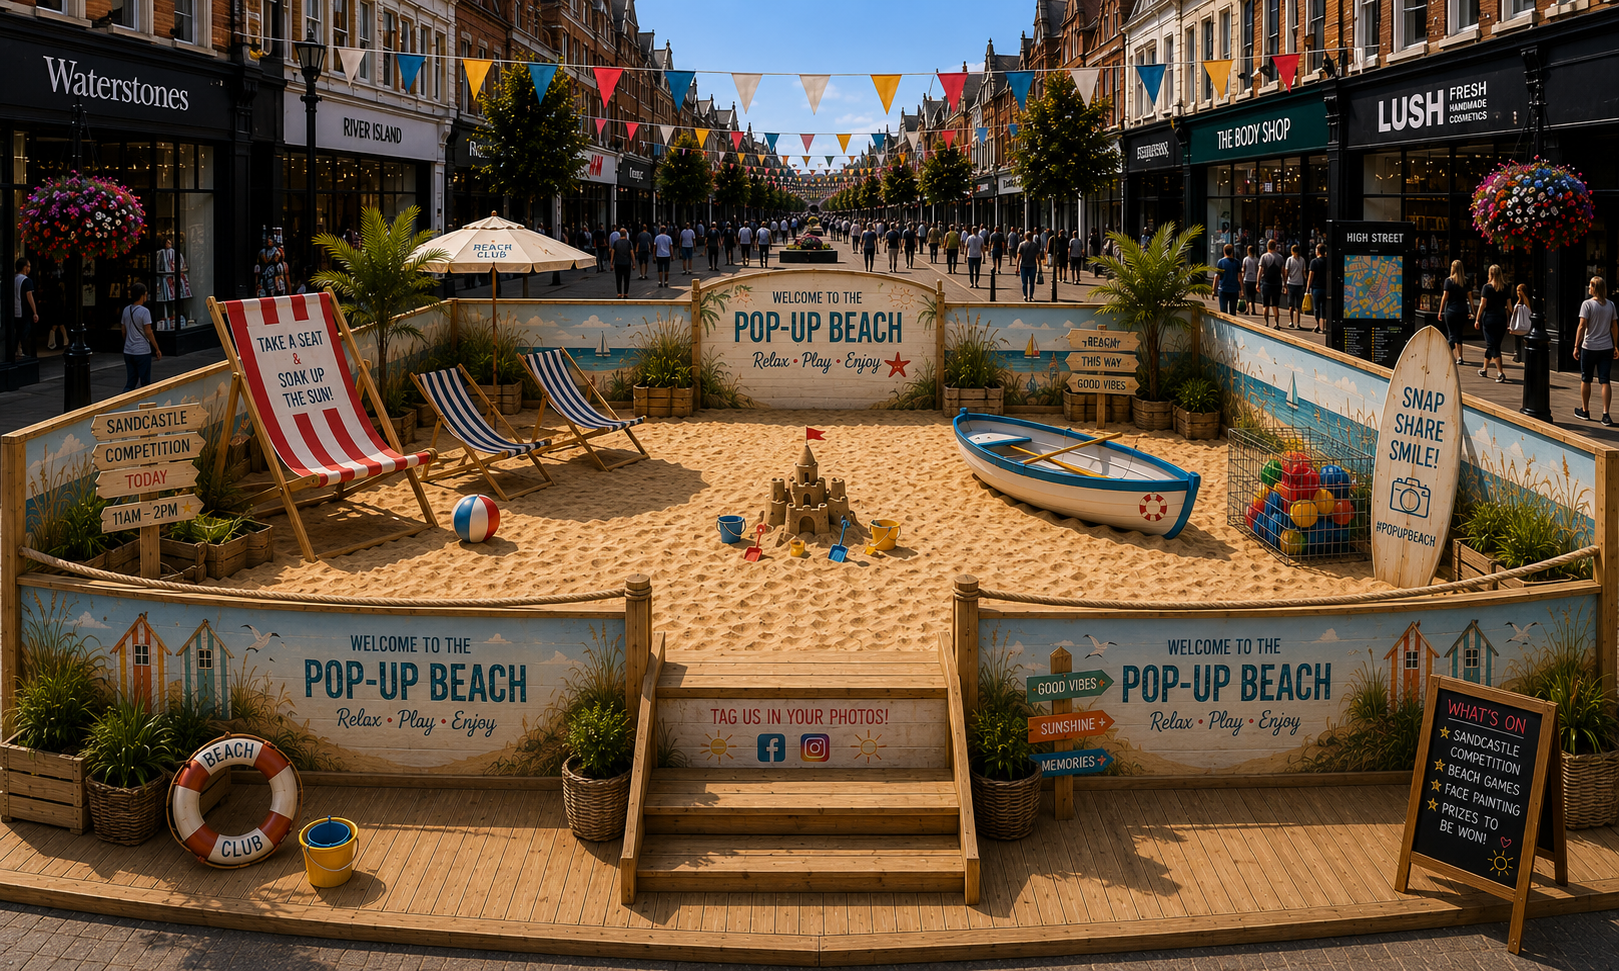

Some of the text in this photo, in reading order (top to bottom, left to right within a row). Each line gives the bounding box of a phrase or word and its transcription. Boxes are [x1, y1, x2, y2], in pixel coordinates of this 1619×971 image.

[43, 55, 189, 111] Waterstones
[1449, 81, 1487, 101] FRESH
[1378, 89, 1445, 133] LUSH
[1449, 98, 1487, 112] HANDMADE
[1449, 111, 1487, 124] COSMETICS
[343, 117, 402, 144] RIVER ISLAND
[1217, 118, 1291, 150] THE BODY SHOP
[1346, 232, 1404, 244] HIGH STREET
[772, 291, 862, 304] WELCOME TO THE
[734, 311, 902, 343] POP-UP BEACH
[256, 330, 324, 352] TAKE A SEAT
[292, 352, 302, 364] &
[752, 352, 882, 375] Relax Play Enjoy
[1081, 356, 1122, 368] THIS WAY
[278, 367, 325, 388] SOAK UP
[1077, 378, 1126, 390] GOOD VIBES
[282, 386, 334, 408] THE SUN!
[1402, 386, 1445, 414] SNAP
[106, 410, 188, 434] SANDCASTLE
[1394, 413, 1445, 442] SHARE
[106, 438, 190, 462] COMPETITION
[1389, 440, 1440, 469] SMILE!
[124, 469, 168, 489] TODAY
[112, 507, 141, 526] 11AM
[153, 502, 178, 519] 2PM
[1376, 520, 1436, 547] #POPUPBEACH
[350, 635, 471, 654] WELCOME TO THE
[1168, 638, 1281, 656] WELCOME TO THE
[304, 659, 527, 703] POP-UP BEACH
[1037, 677, 1097, 696] GOOD VIBES
[1122, 662, 1331, 703] POP-UP BEACH
[336, 708, 497, 737] Relax Play Enjoy
[710, 708, 889, 724] TAG US IN YOUR PHOTOS!
[1041, 717, 1096, 736] SUNSHINE
[1150, 710, 1301, 736] Relax Play Enjoy
[1448, 699, 1527, 734] WHAT'S ON
[202, 742, 255, 768] BEACH
[1453, 730, 1520, 758] SANDCASTLE
[1041, 755, 1095, 772] MEMORIES
[1450, 746, 1521, 776] COMPETITION
[1448, 764, 1520, 796] BEACH GAMES
[1444, 783, 1521, 817] FACE PAINTING
[1442, 803, 1499, 831] PRIZES TO
[1440, 819, 1487, 845] BE WON!
[222, 835, 263, 858] CLUB
